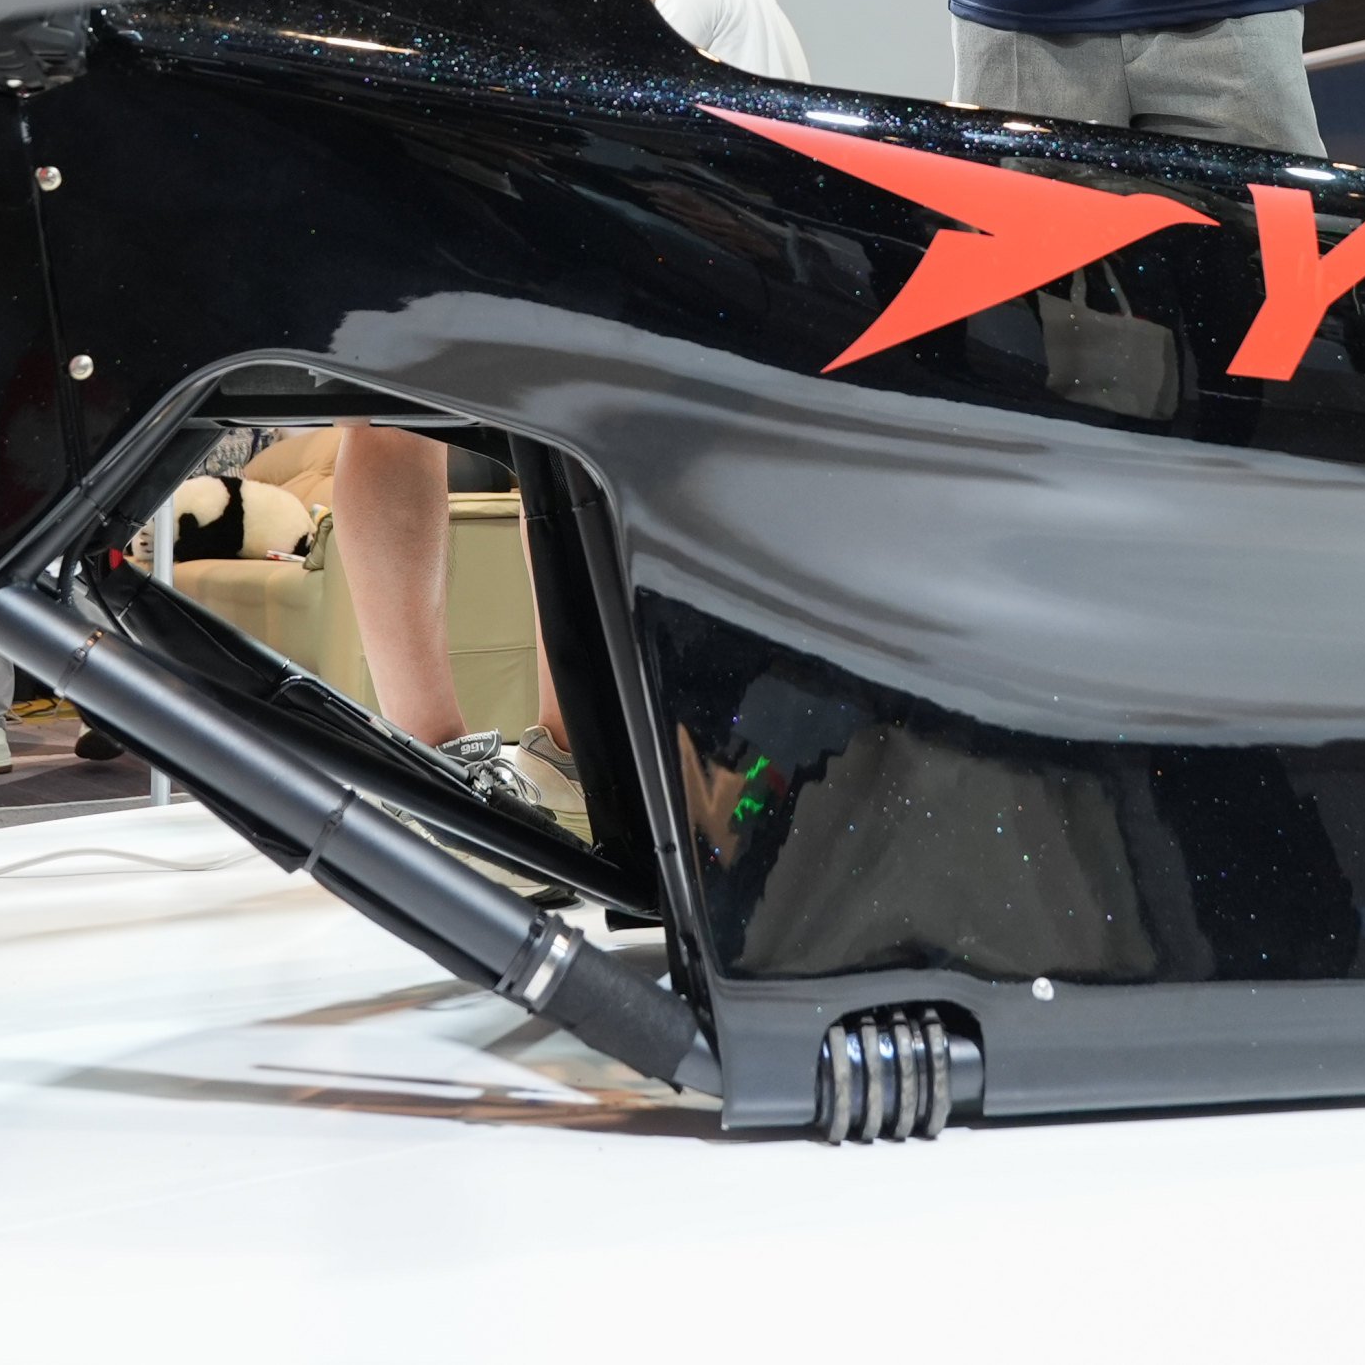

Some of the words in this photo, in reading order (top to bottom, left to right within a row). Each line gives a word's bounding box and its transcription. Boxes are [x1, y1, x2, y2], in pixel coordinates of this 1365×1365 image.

[442, 738, 460, 749] new
[460, 732, 493, 743] balance
[460, 741, 484, 755] 991
